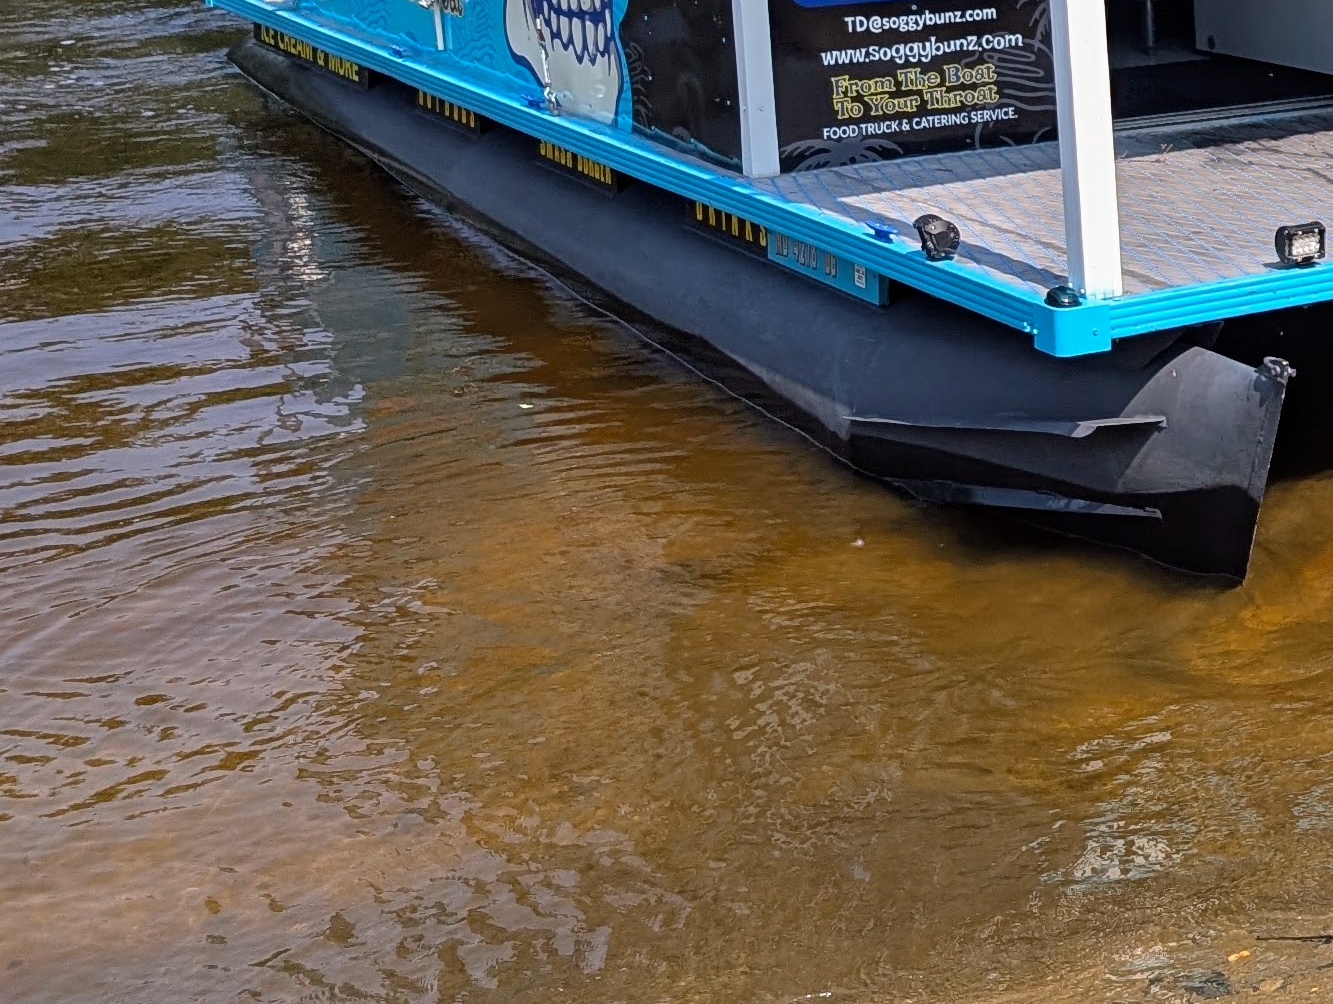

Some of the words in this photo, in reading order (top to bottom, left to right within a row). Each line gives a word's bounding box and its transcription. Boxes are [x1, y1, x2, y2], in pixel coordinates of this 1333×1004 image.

[844, 7, 997, 34] TD@soggybunz.com
[831, 75, 896, 99] From
[897, 67, 940, 91] The
[943, 62, 998, 87] Boat
[833, 97, 863, 120] To
[864, 93, 920, 116] Your
[923, 84, 1000, 110] Throat
[823, 124, 858, 140] FOOD
[859, 121, 899, 137] TRUCK
[901, 119, 910, 132] &
[911, 112, 968, 130] CATERING
